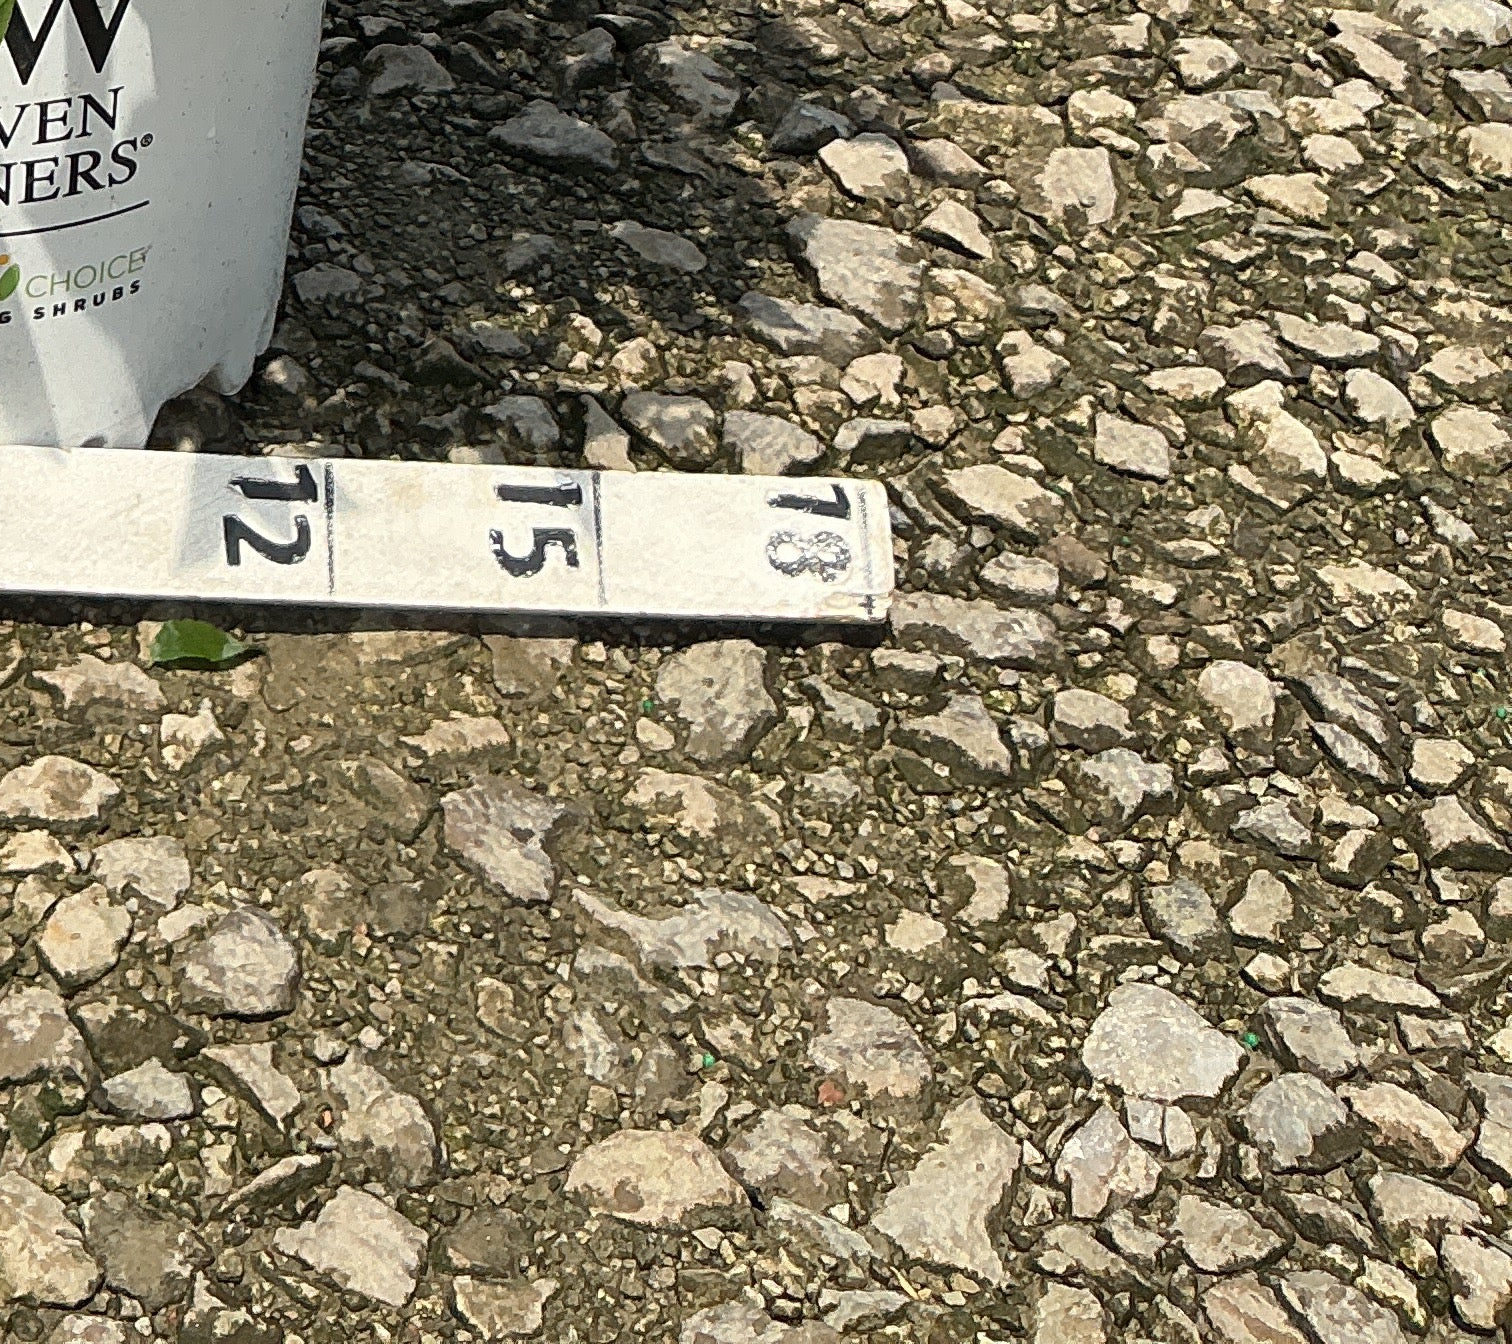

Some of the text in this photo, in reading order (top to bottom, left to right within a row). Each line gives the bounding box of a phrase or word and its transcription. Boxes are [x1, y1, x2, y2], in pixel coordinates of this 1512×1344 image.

[25, 246, 148, 300] CHOICE
[33, 278, 143, 320] SHRUBS
[223, 462, 319, 568] 12
[488, 478, 583, 579] 15
[764, 483, 852, 583] 18
